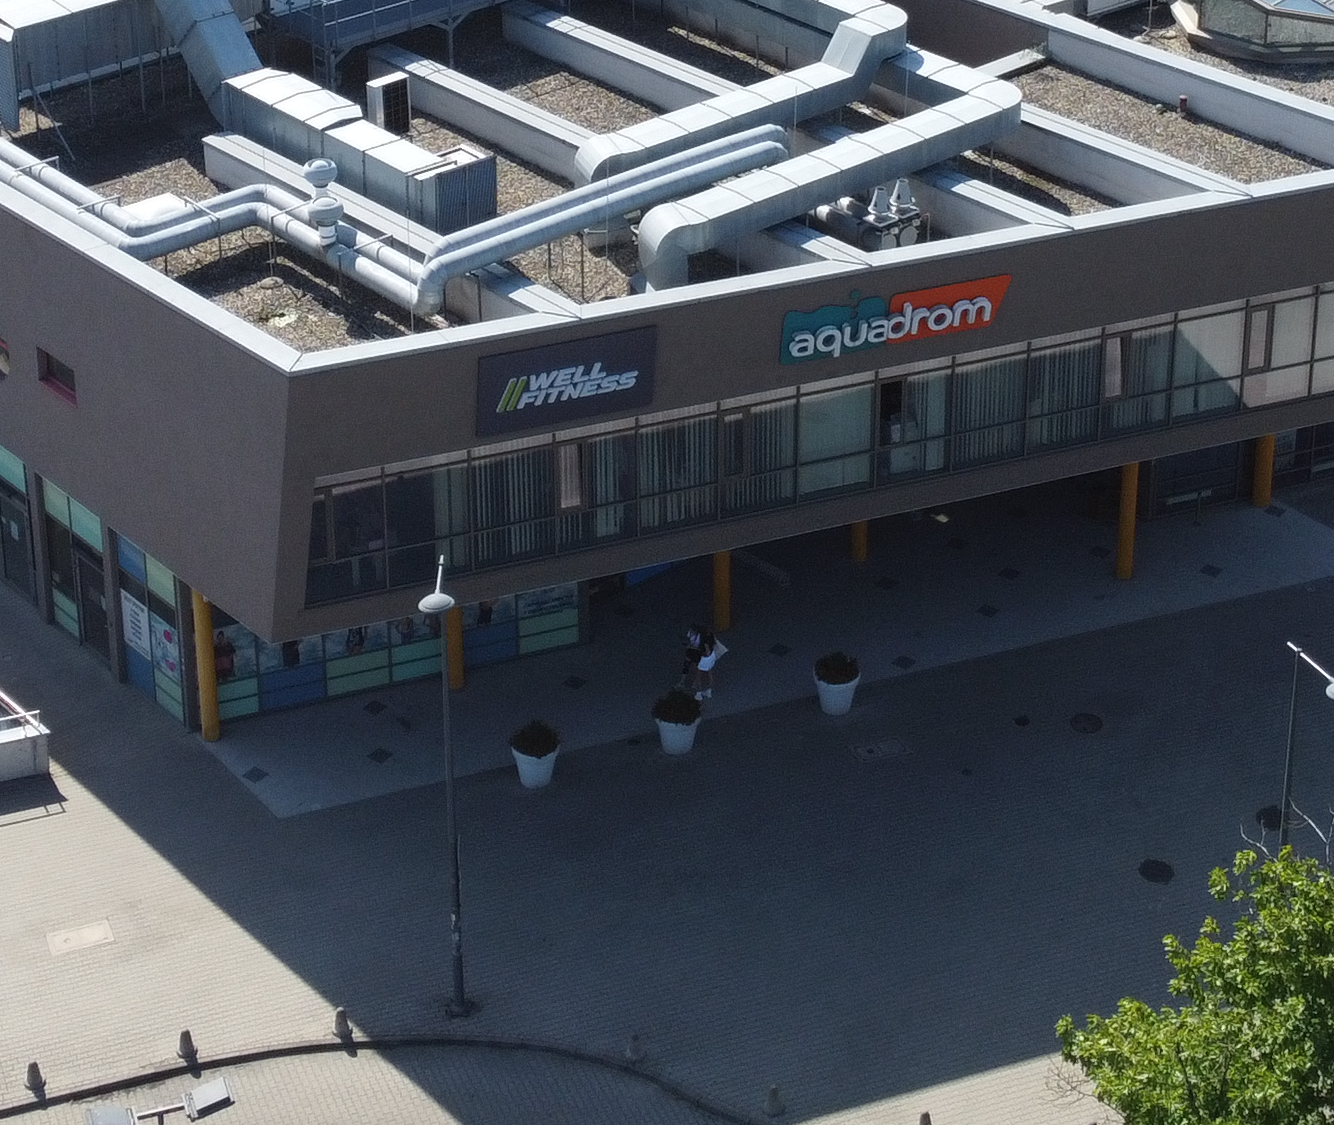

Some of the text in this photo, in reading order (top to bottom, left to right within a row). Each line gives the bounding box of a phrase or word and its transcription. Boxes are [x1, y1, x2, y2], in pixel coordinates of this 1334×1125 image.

[789, 296, 992, 358] aquadrom
[517, 370, 639, 409] FITNESS
[529, 362, 607, 391] WELL
